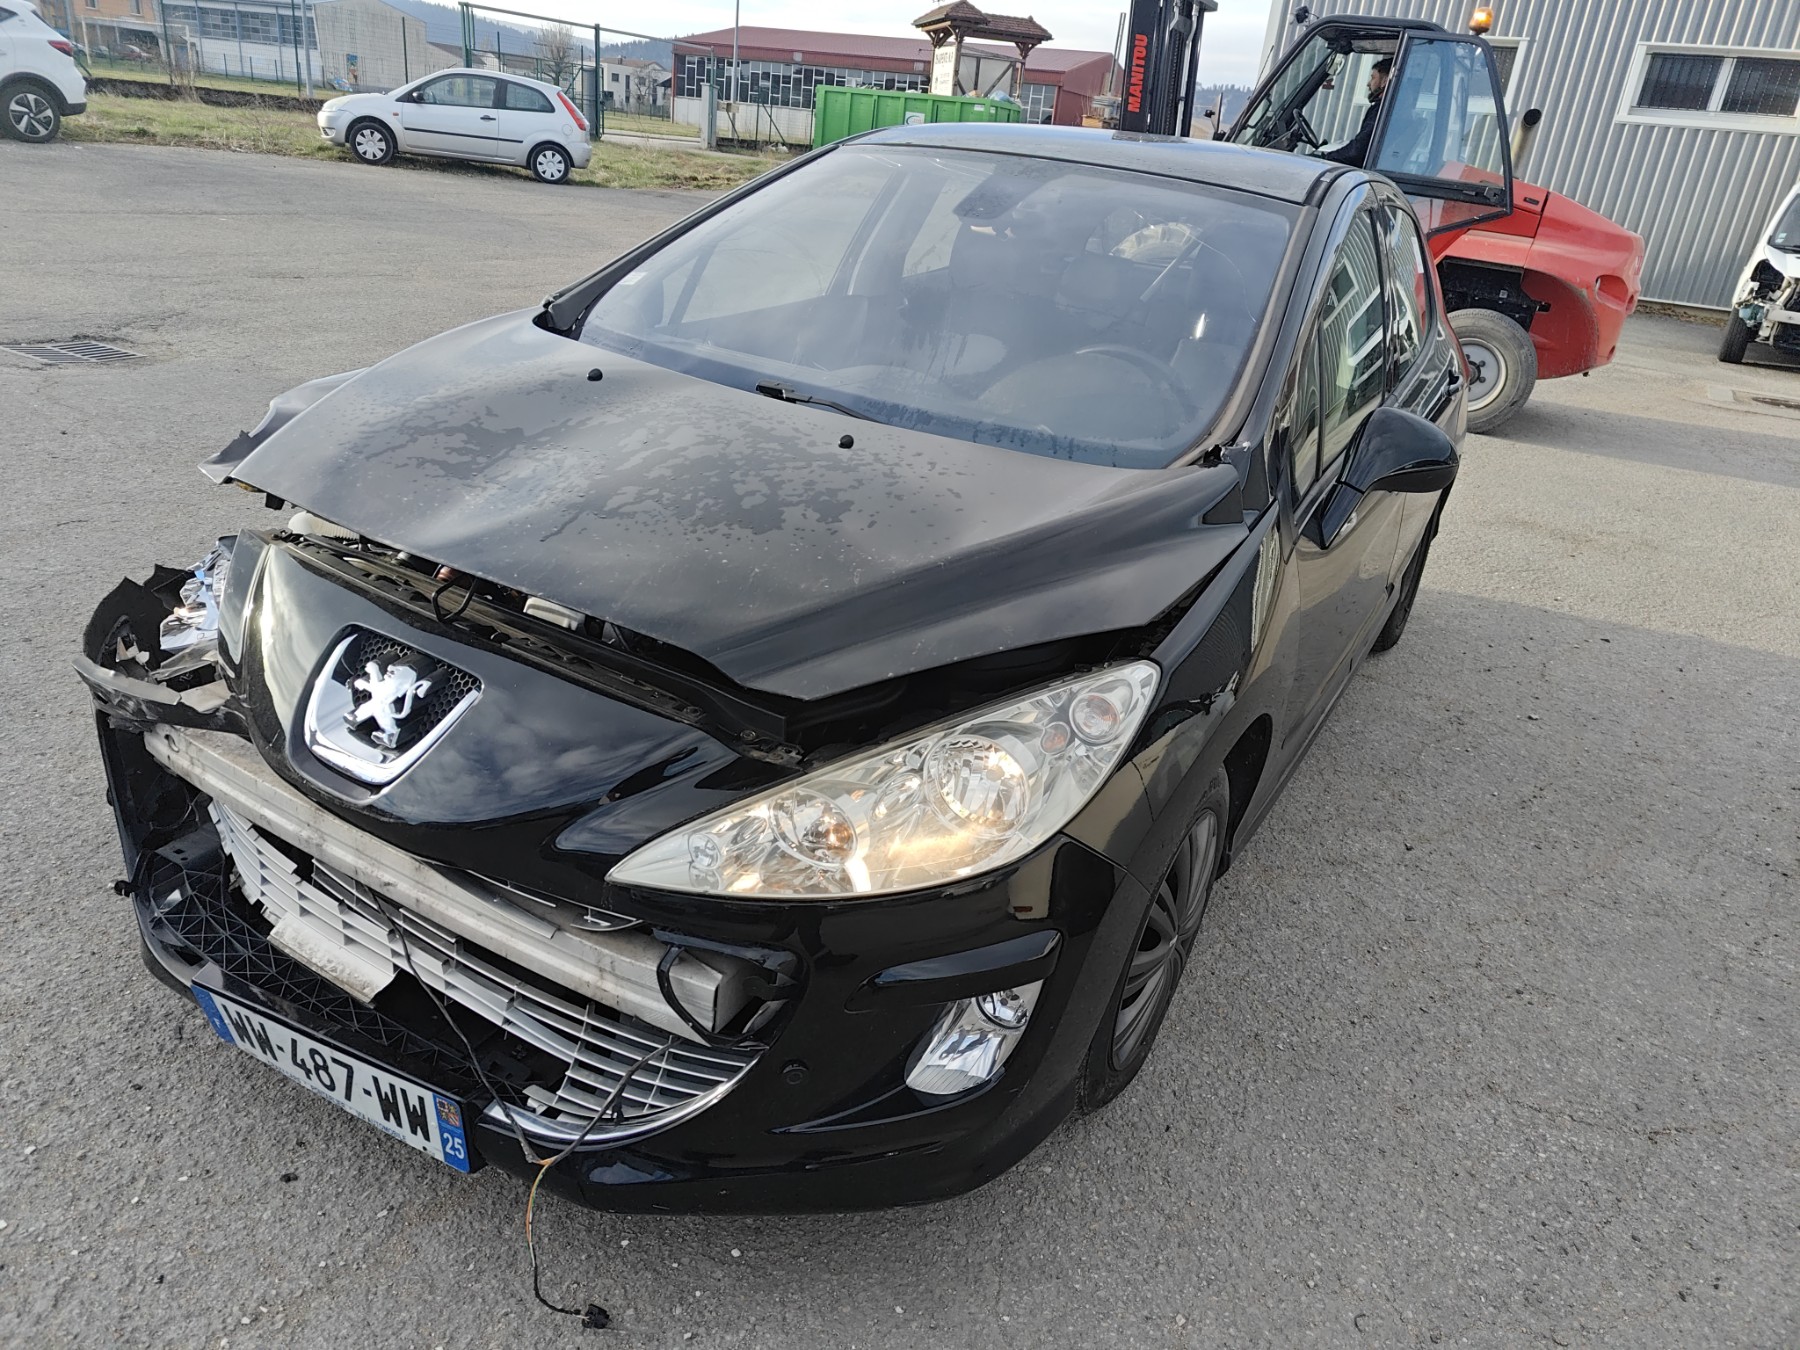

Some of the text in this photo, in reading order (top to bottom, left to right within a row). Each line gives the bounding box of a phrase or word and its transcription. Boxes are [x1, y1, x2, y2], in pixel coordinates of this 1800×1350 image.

[1128, 33, 1148, 113] MANITOU
[221, 1003, 431, 1143] WW-487-WW
[443, 1132, 465, 1160] 25
